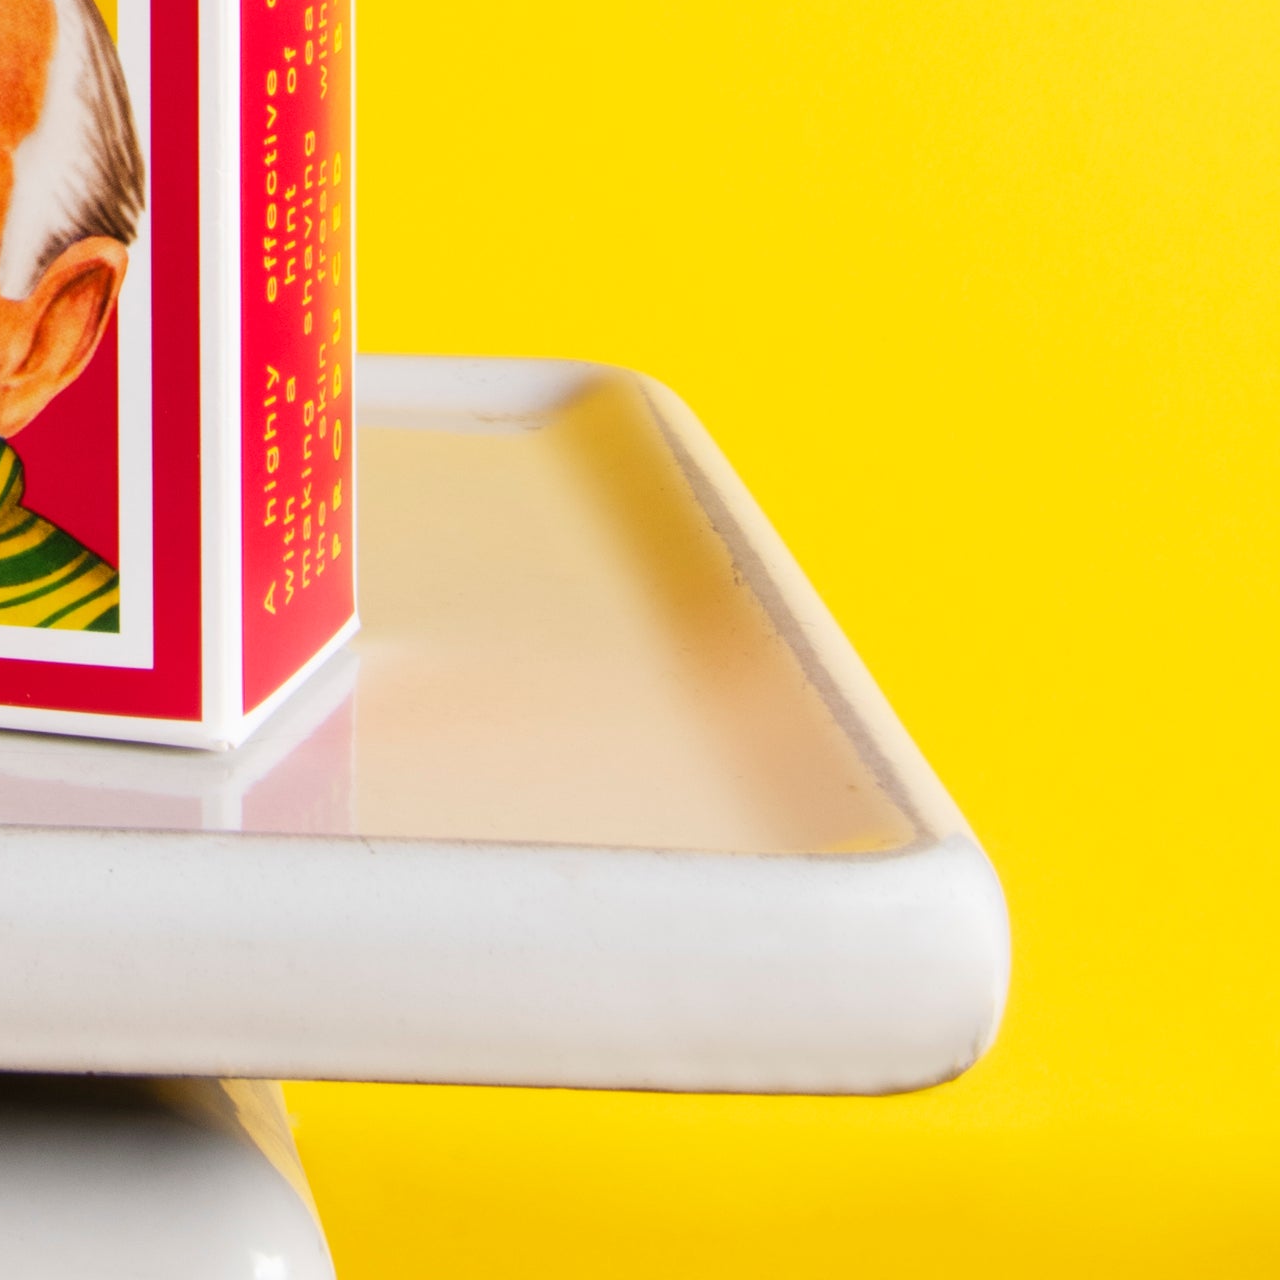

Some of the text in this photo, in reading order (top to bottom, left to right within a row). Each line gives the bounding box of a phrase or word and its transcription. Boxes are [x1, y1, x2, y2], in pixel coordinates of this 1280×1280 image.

[284, 47, 296, 94] of
[264, 69, 277, 302] effective
[284, 184, 296, 285] hint
[302, 130, 315, 335] shaving
[317, 160, 327, 283] fresh
[286, 376, 296, 403] a
[317, 343, 327, 438] skin
[332, 151, 342, 560] PRODUCED
[264, 365, 279, 527] highly
[301, 400, 314, 589] making
[283, 497, 295, 605] with
[316, 501, 326, 576] the
[264, 581, 276, 615] A
